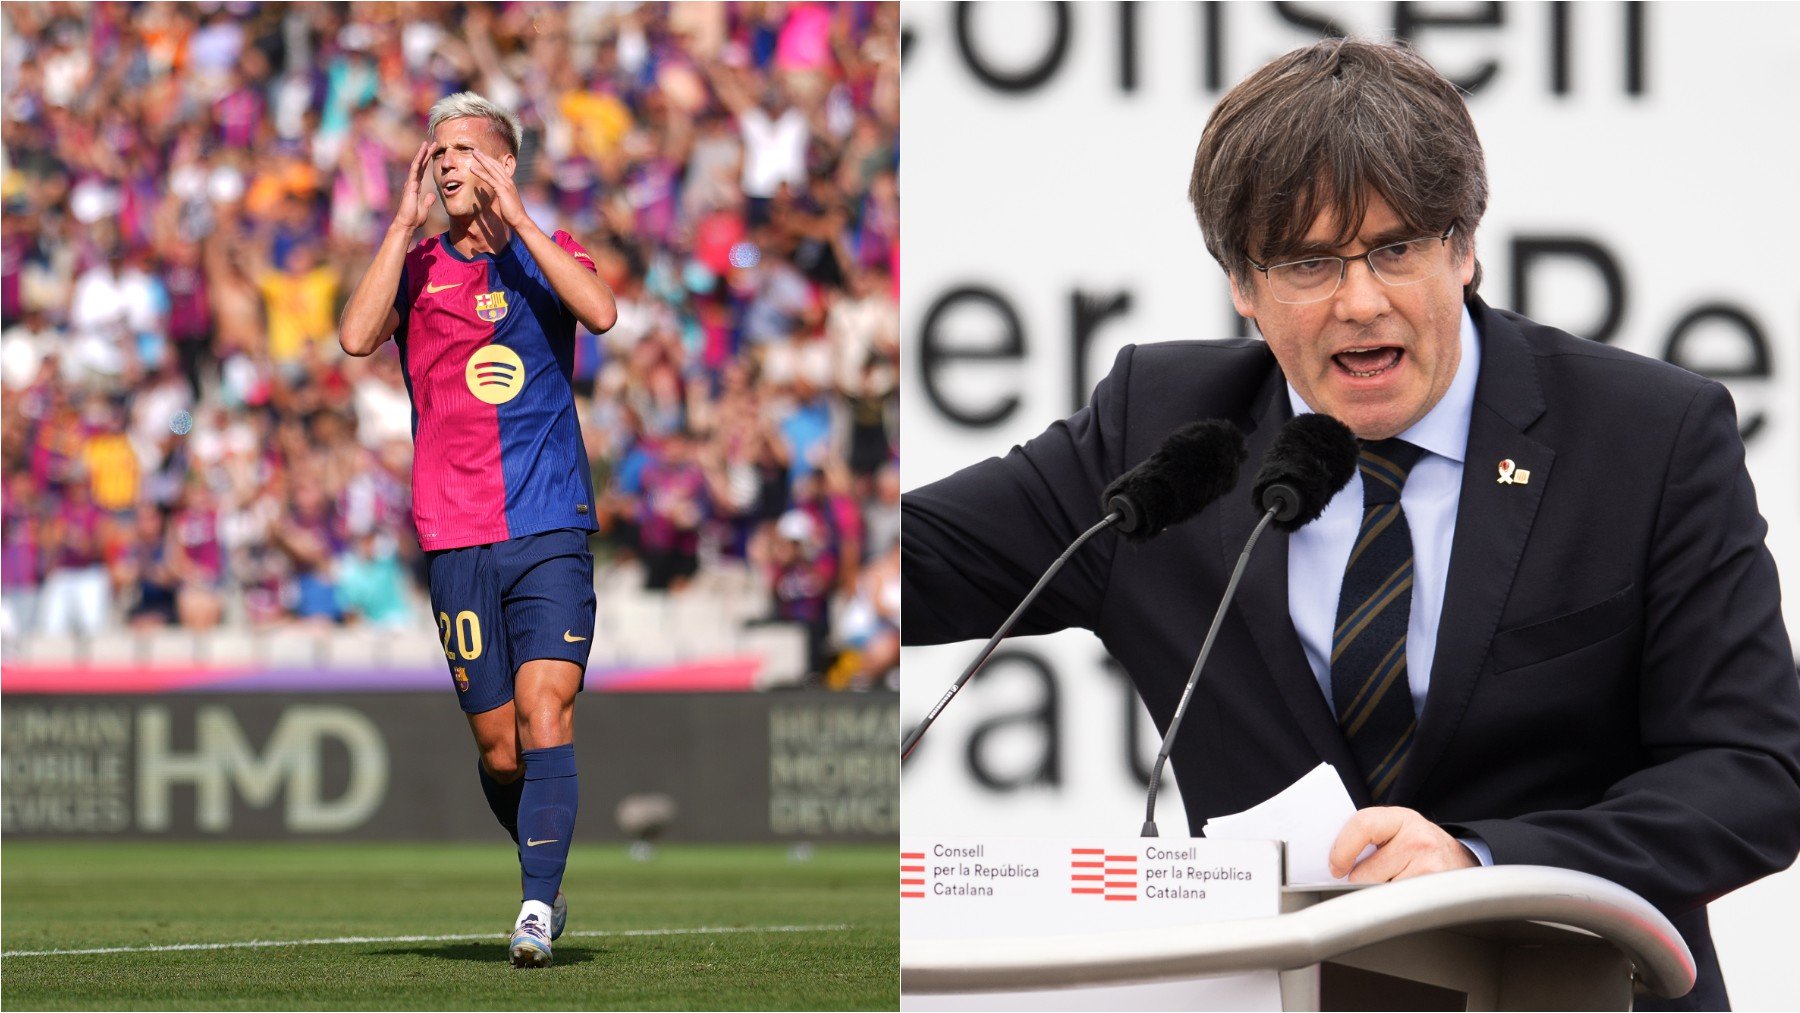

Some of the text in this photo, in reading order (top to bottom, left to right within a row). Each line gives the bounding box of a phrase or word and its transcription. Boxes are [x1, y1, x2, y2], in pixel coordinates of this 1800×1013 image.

[440, 610, 482, 660] 20
[901, 645, 1166, 792] at
[137, 705, 390, 833] HMD
[933, 844, 984, 857] Consell
[1146, 846, 1196, 860] Consell
[934, 863, 1039, 880] per la República
[1146, 866, 1252, 883] per la República
[933, 882, 993, 896] Catalana
[1145, 885, 1206, 899] Catalana
